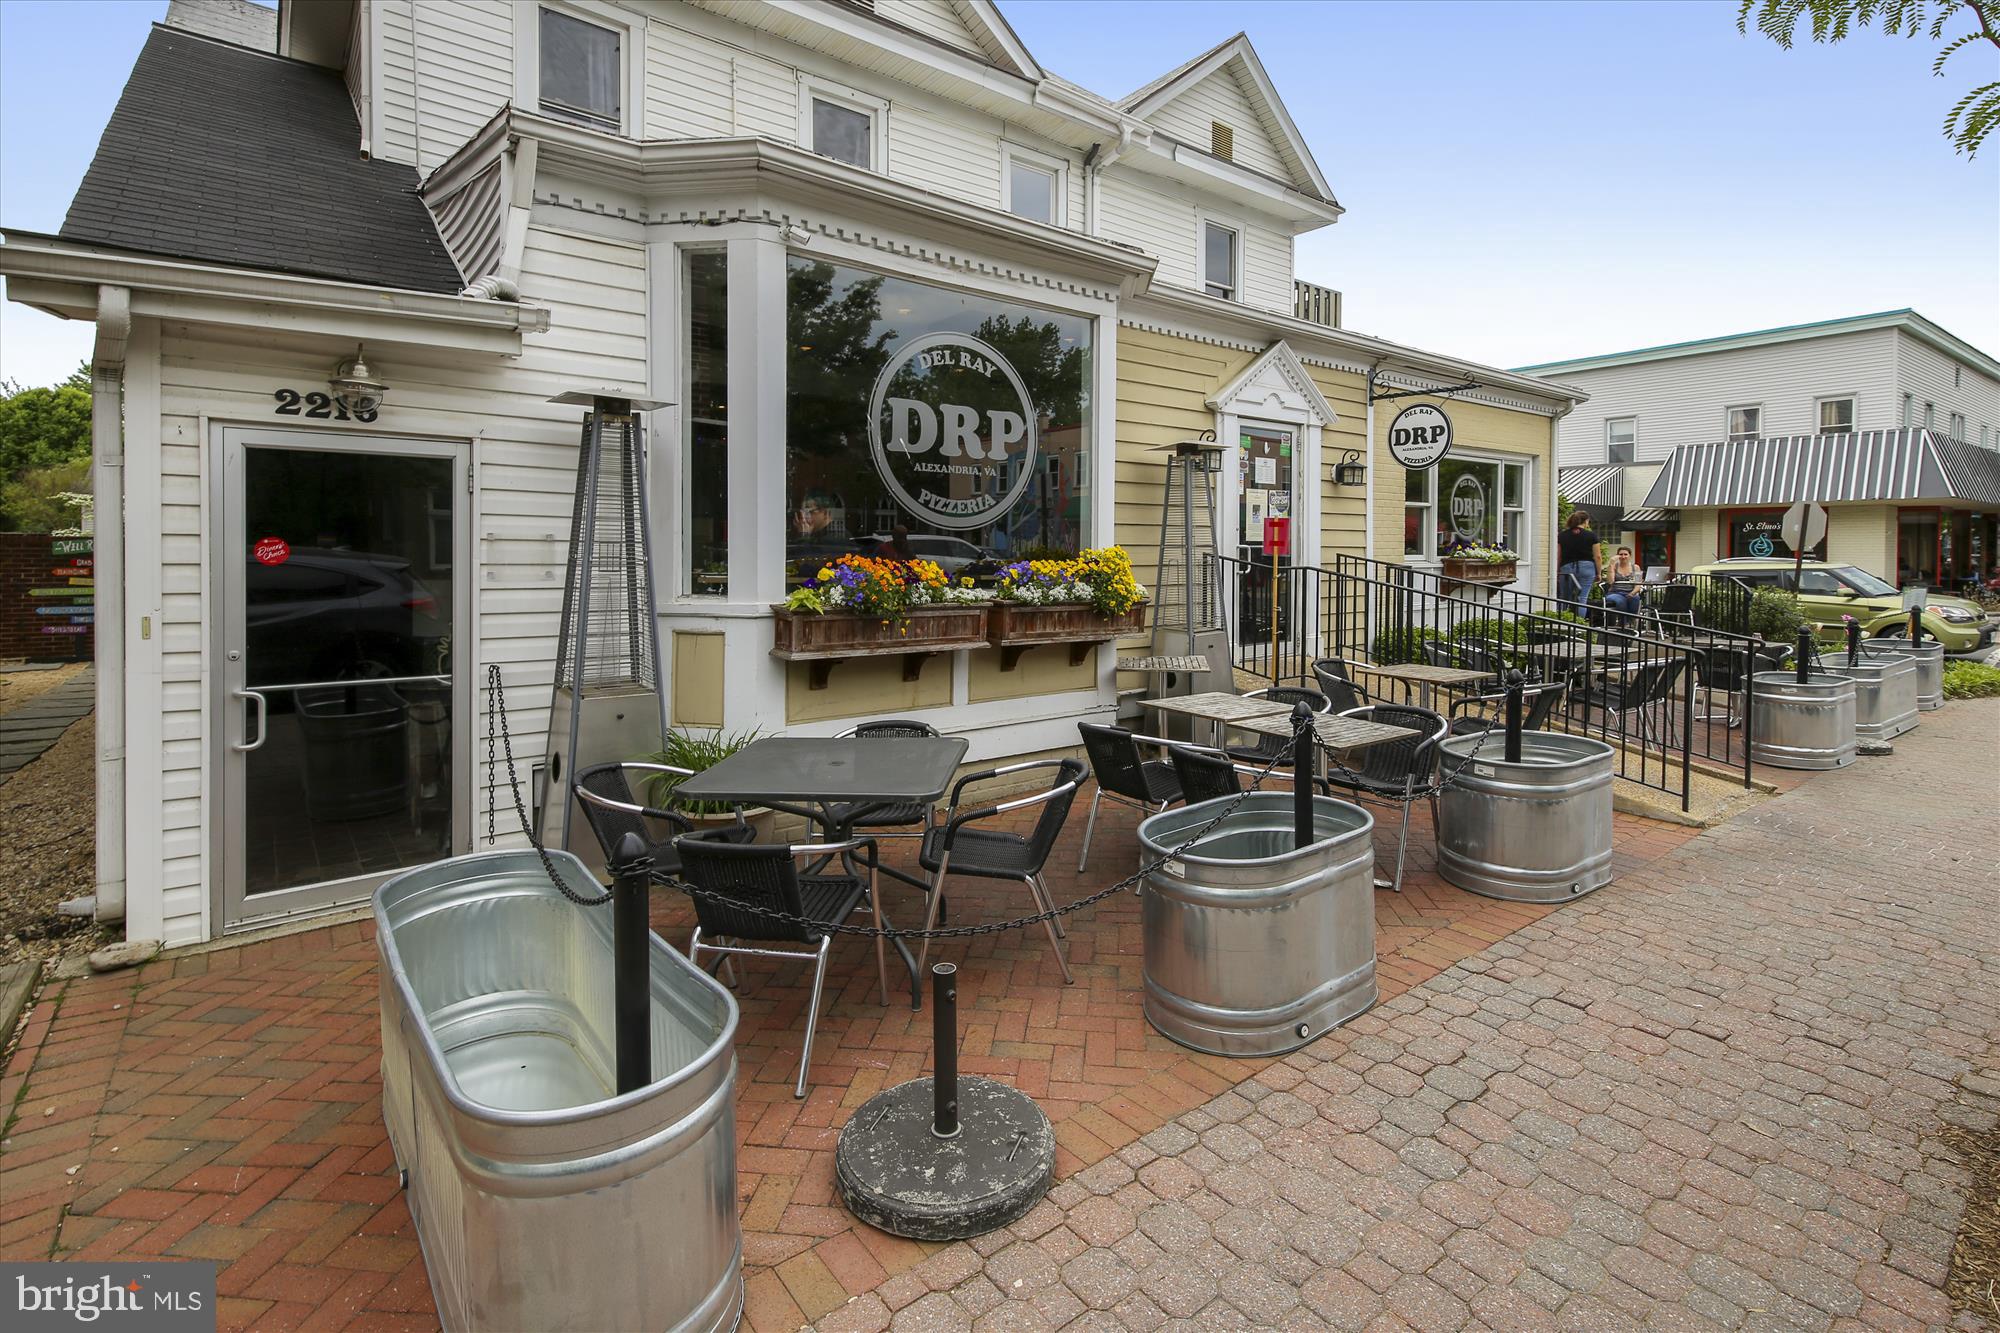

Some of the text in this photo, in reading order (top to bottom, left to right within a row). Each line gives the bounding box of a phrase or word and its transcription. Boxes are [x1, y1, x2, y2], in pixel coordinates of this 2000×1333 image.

[918, 350, 998, 378] DEL RAY
[1404, 408, 1434, 418] DEL RAY
[886, 397, 1026, 461] DRP
[1393, 424, 1446, 447] DRP
[1403, 455, 1433, 464] PIZZERIA
[985, 465, 997, 477] VA
[918, 488, 997, 514] PIZZERIA
[1453, 496, 1483, 517] DRP
[1742, 521, 1782, 532] St. Elmo's
